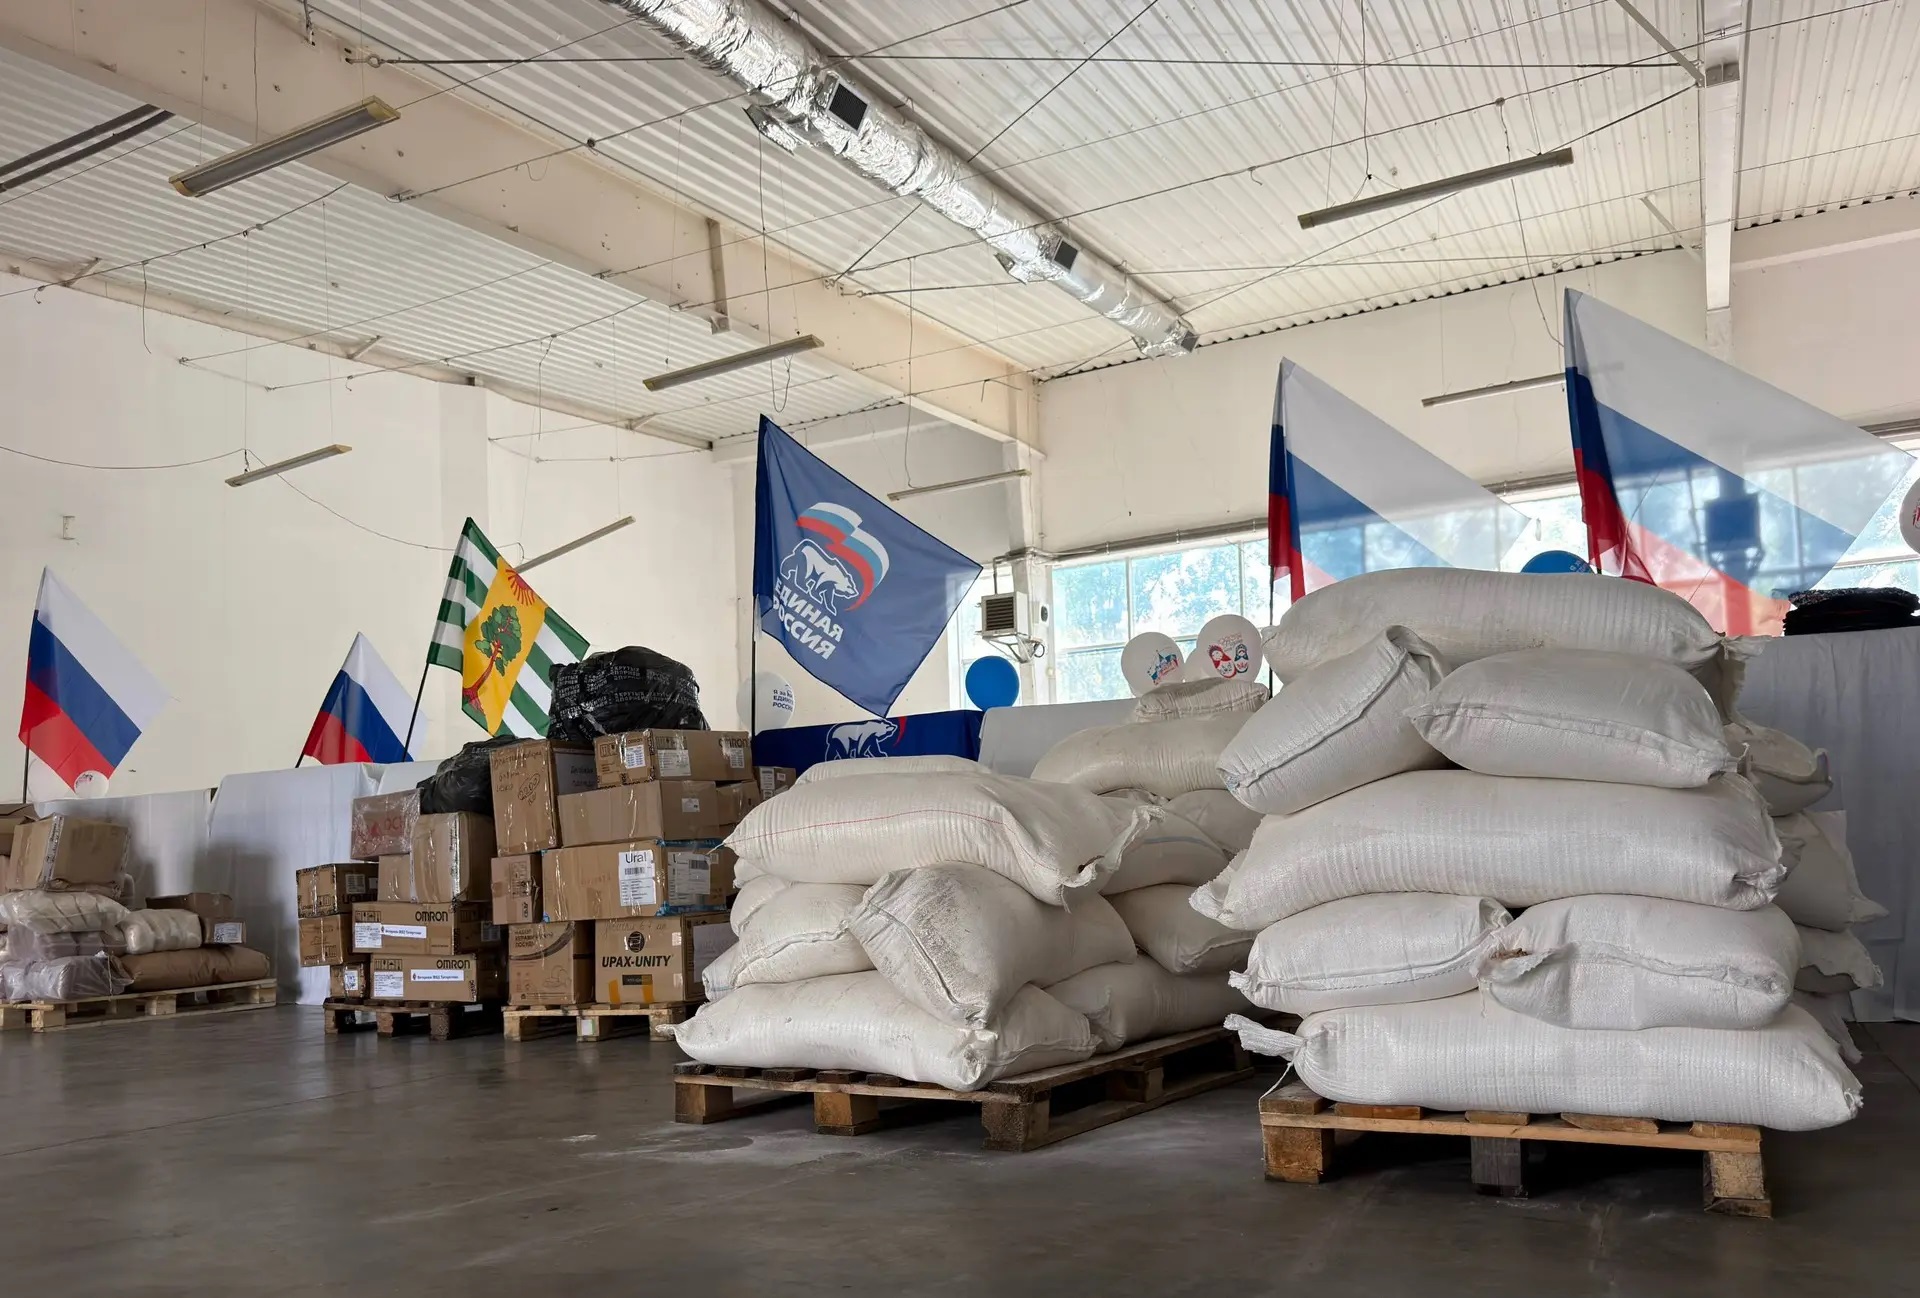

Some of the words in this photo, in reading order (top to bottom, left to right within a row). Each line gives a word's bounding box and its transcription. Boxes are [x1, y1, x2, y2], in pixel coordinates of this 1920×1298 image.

[775, 577, 844, 643] ЕДИНАЯ
[773, 595, 836, 660] РОССИЯ
[625, 852, 647, 864] Ural
[415, 911, 449, 922] OMRON
[436, 959, 471, 969] OMRON
[602, 955, 671, 967] UPAX-UNITY
